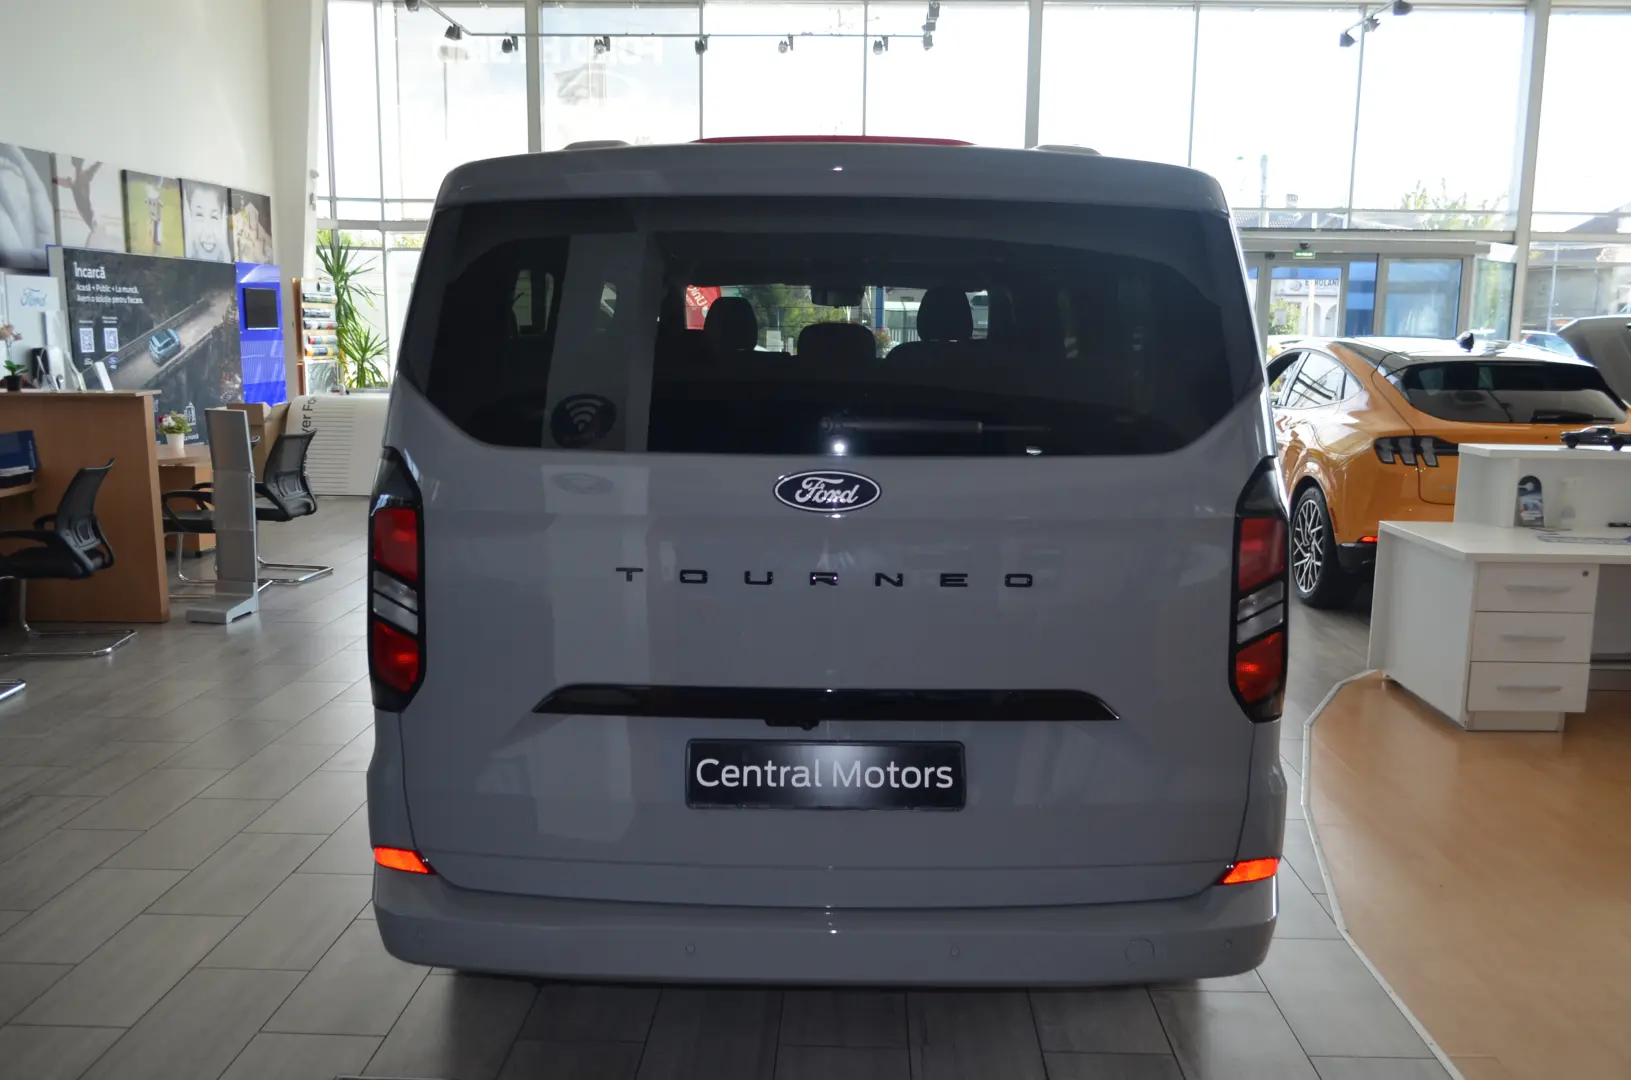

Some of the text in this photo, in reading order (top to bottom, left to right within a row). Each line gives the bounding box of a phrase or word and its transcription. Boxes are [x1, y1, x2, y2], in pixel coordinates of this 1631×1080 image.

[73, 261, 106, 279] Încarcă
[20, 287, 47, 306] Ford
[795, 477, 860, 503] Ford
[616, 567, 1034, 588] TOURNEO
[696, 758, 953, 789] Central Motors
